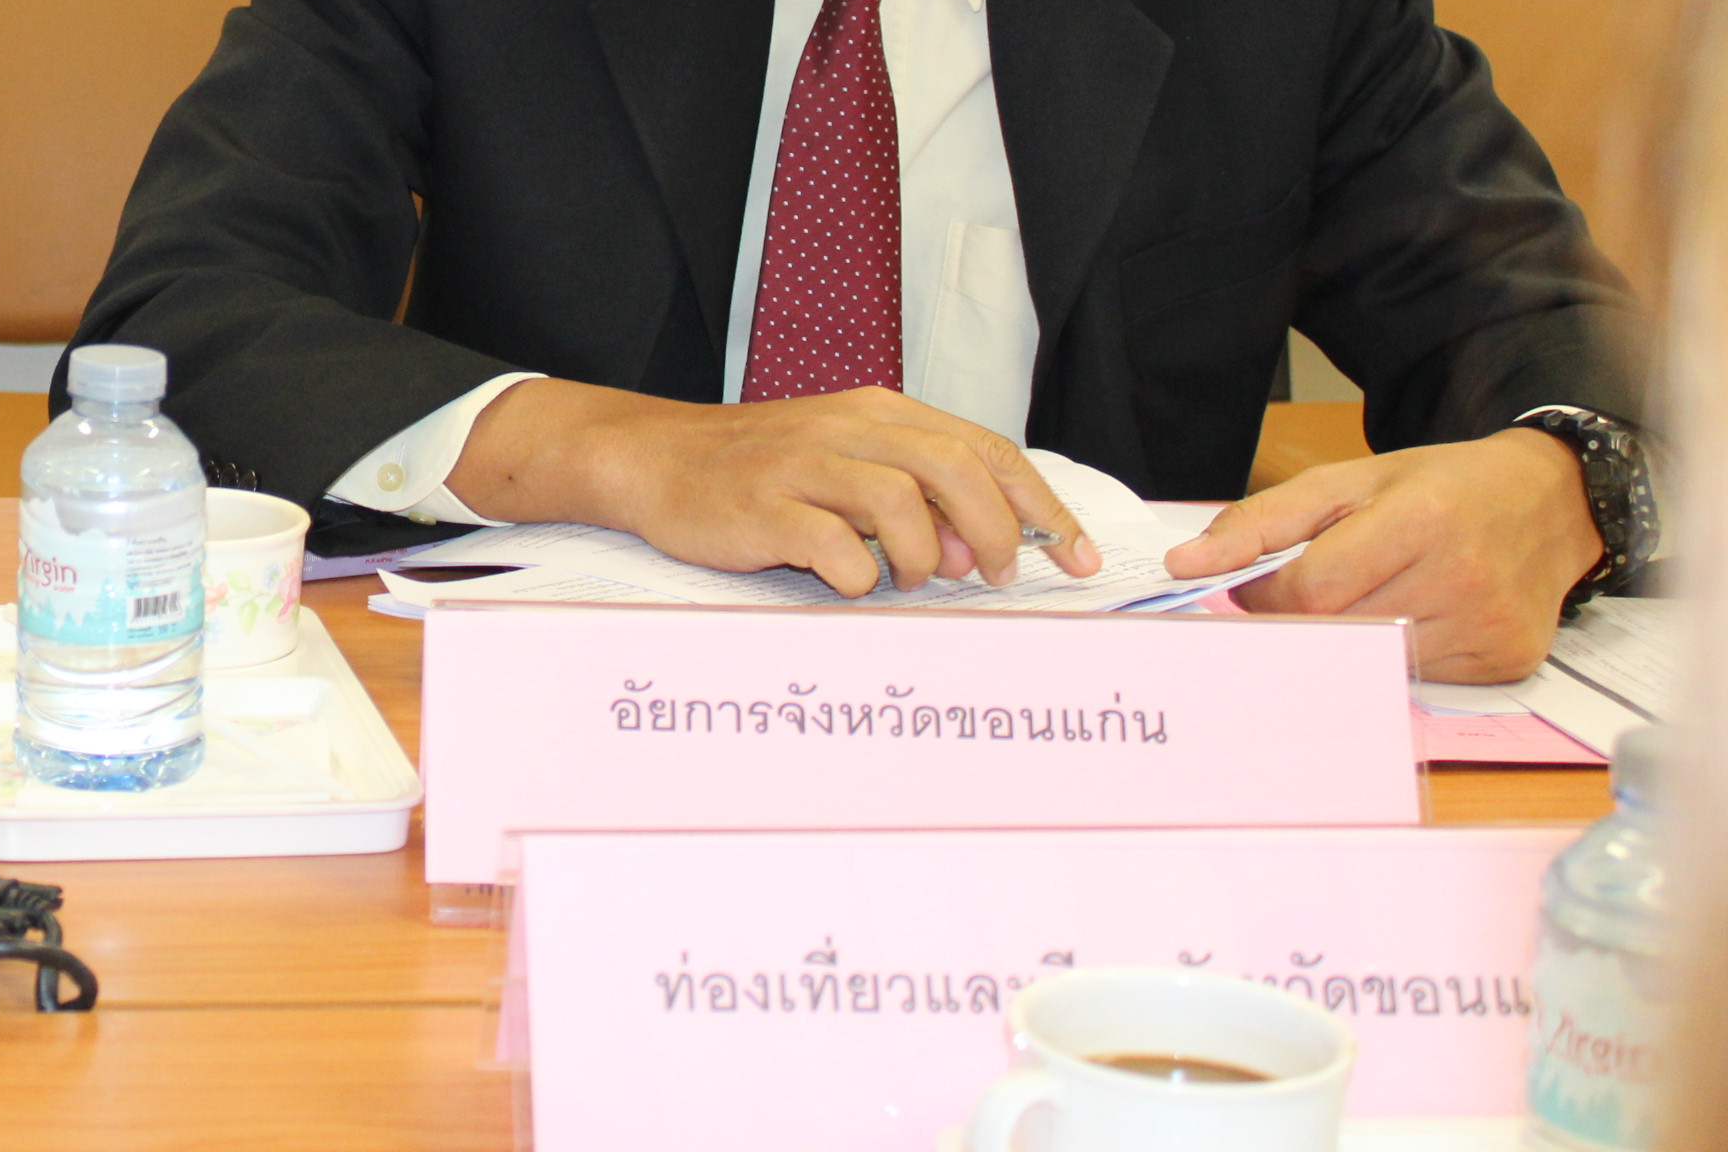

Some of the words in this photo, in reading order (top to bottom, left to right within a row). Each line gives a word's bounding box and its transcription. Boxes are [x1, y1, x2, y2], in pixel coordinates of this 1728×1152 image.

[609, 678, 1168, 745] อัยการจังหวัดขอนแก่น
